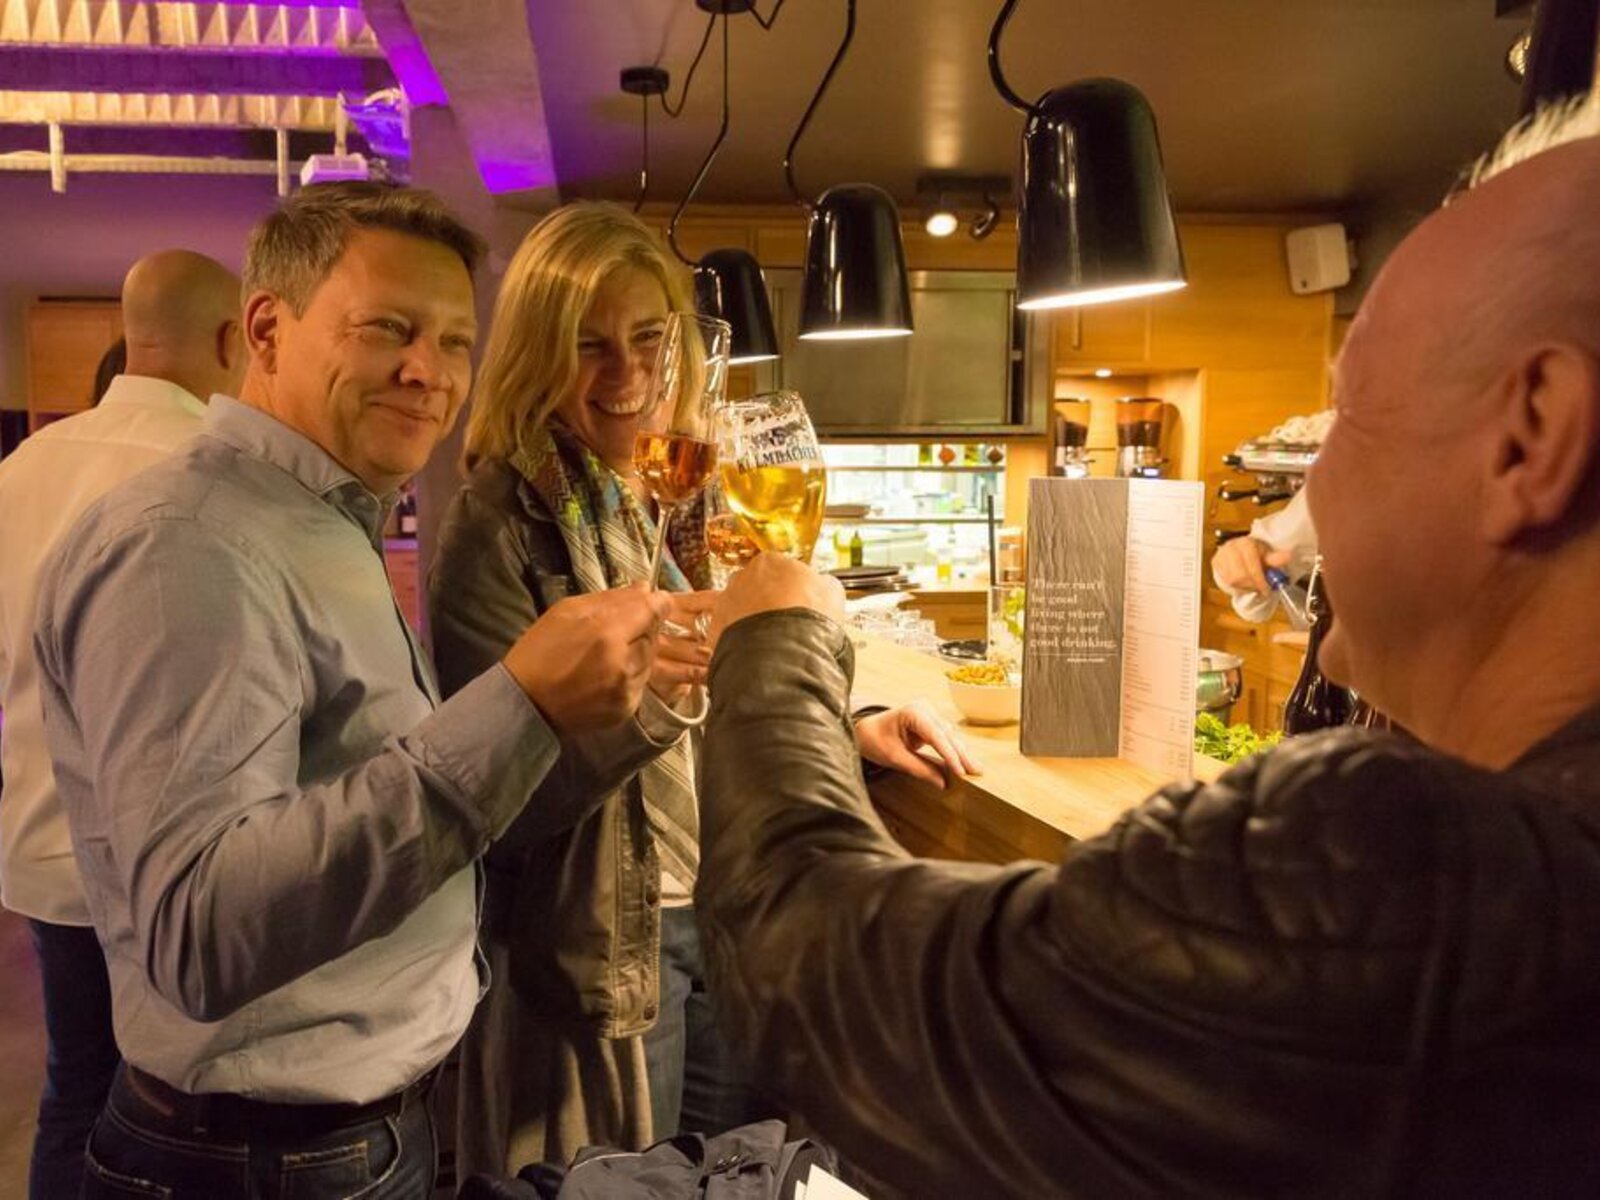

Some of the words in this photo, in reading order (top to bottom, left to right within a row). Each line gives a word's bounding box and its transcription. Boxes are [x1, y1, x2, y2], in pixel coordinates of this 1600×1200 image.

[1031, 592, 1045, 603] be
[1047, 593, 1077, 606] good
[1031, 607, 1065, 620] living
[1067, 608, 1105, 619] where
[1066, 622, 1077, 633] is
[1029, 636, 1058, 649] good
